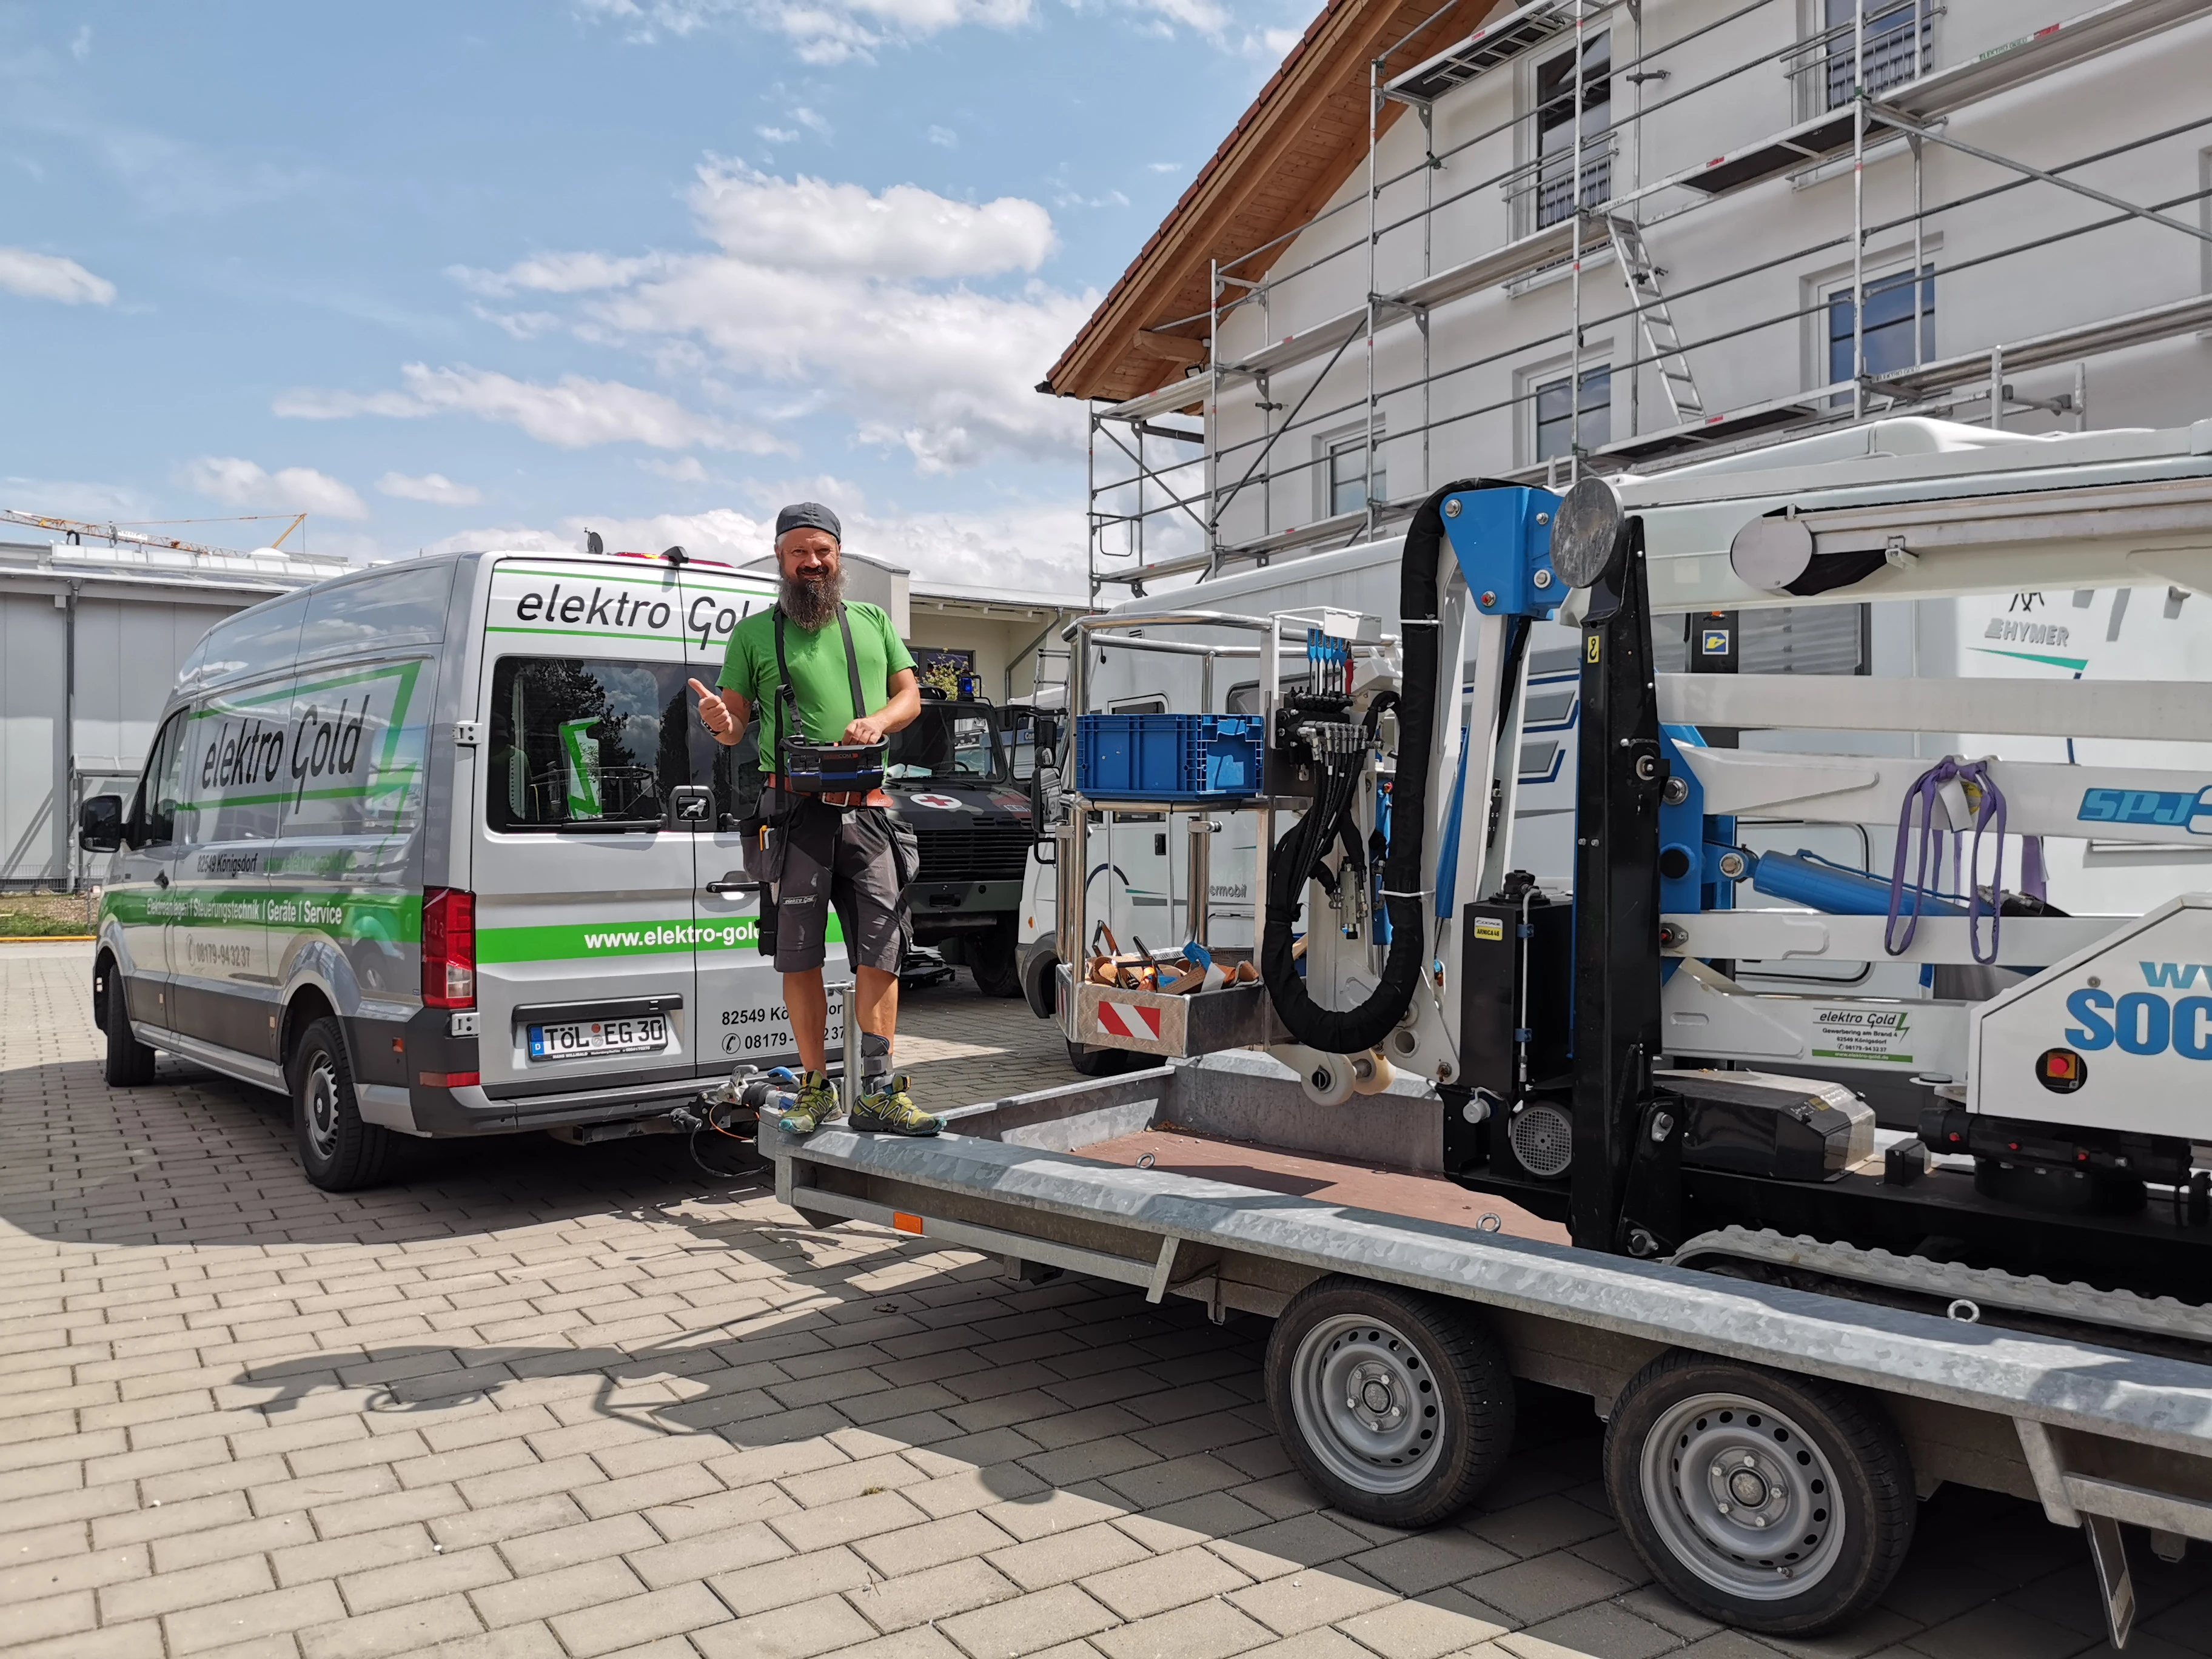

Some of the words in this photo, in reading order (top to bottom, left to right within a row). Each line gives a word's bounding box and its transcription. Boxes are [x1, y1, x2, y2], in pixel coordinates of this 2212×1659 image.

[517, 584, 671, 629] elektro
[2003, 620, 2070, 647] HYMER
[202, 718, 284, 789] elektro
[292, 694, 370, 815] Gold
[2080, 789, 2195, 823] SPJ
[216, 853, 258, 878] Königsdorf
[1209, 883, 1247, 898] ermobil
[147, 897, 190, 920] Elektroanlagen
[194, 898, 260, 923] Steuerungstechnik
[267, 900, 297, 922] Geräte
[304, 900, 343, 925] Service
[722, 1008, 765, 1025] 82549
[1820, 1011, 1863, 1024] elektro
[1867, 1013, 1897, 1029] Gold
[545, 1026, 589, 1051] TÖL
[604, 1022, 633, 1045] EG
[637, 1019, 663, 1042] 30
[1822, 1027, 1861, 1036] Gewerbering
